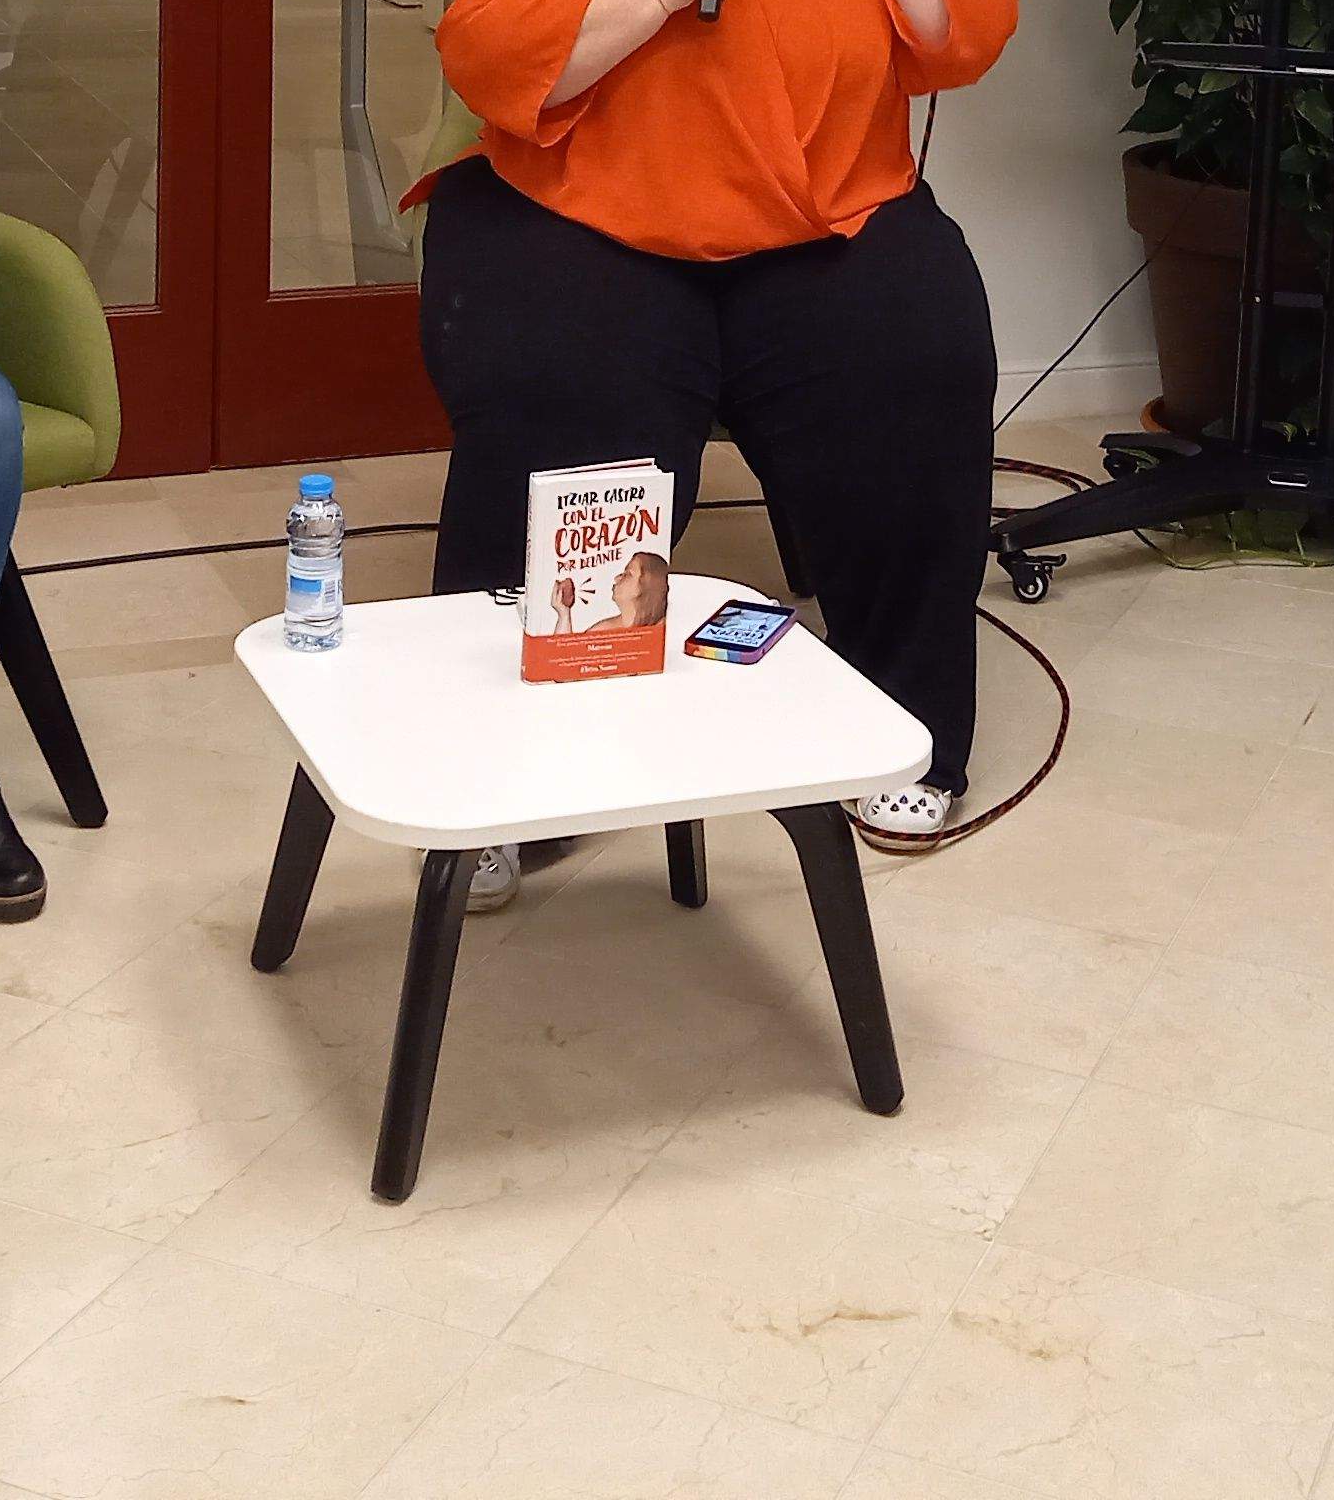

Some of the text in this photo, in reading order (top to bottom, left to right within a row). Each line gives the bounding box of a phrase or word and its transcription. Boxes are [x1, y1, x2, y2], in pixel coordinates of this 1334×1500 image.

[557, 486, 646, 509] ITZIAR CASTRO
[563, 506, 605, 525] CON EL
[555, 505, 660, 558] CORAZÓN
